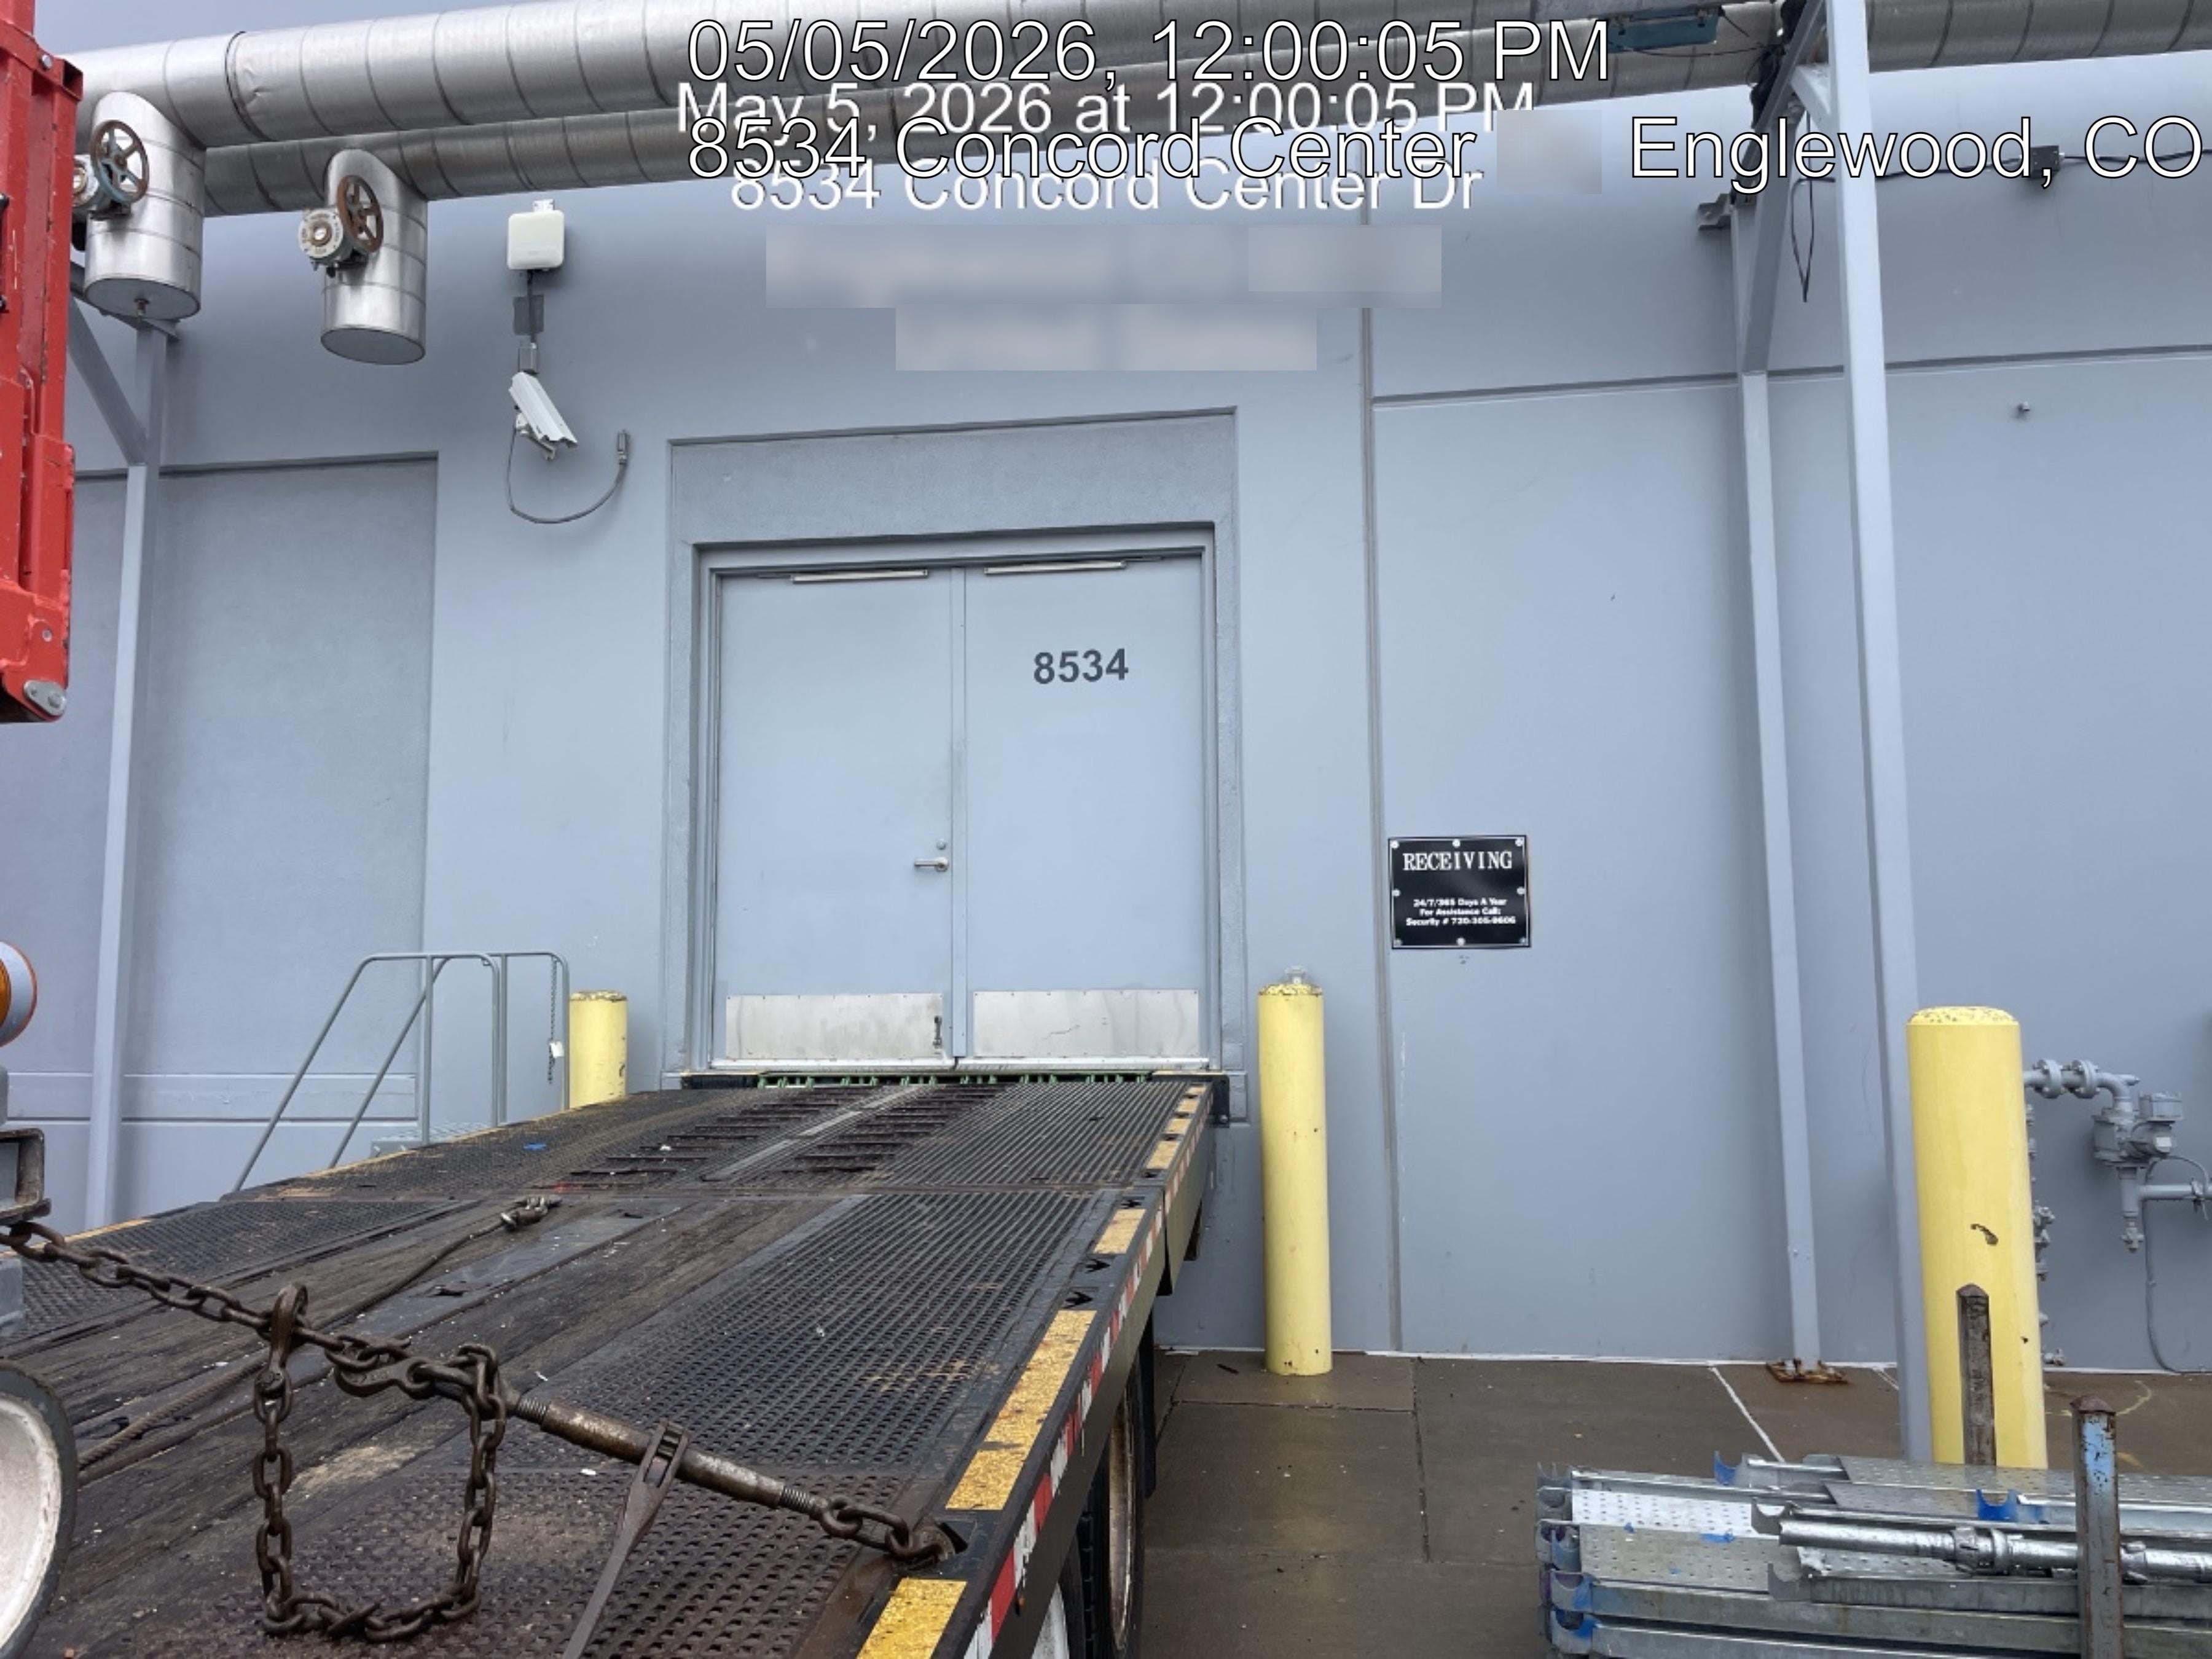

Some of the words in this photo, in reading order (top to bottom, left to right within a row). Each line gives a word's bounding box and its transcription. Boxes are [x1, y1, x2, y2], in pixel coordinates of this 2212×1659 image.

[1033, 648, 1129, 684] 8534
[1403, 851, 1512, 871] RECEIVING
[1435, 907, 1480, 916] Assistance
[1406, 917, 1440, 927] Security
